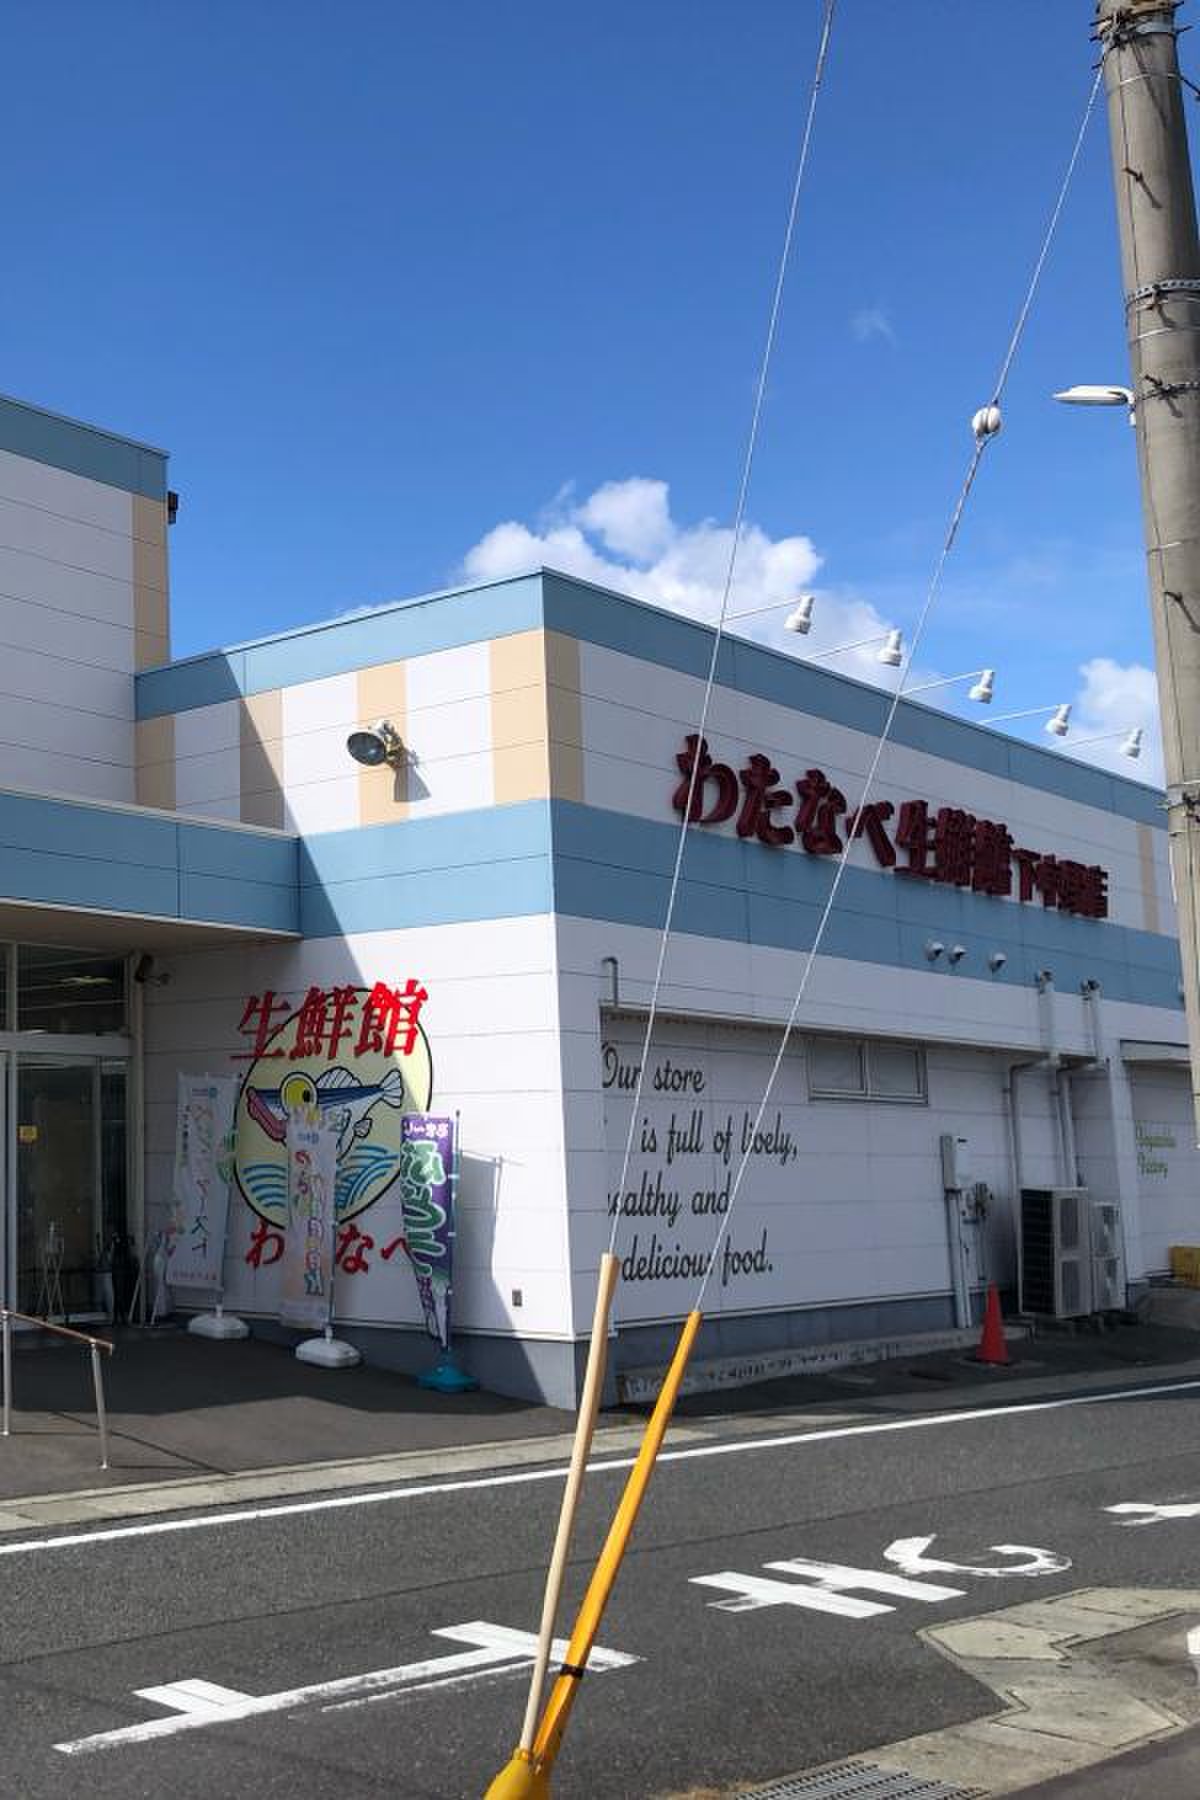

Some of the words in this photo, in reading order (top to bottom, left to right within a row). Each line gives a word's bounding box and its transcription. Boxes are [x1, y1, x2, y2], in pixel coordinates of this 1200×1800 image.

[230, 979, 428, 1060] 生鮮館
[654, 1060, 704, 1092] store
[640, 1119, 657, 1152] is
[667, 1109, 703, 1165] full
[713, 1115, 732, 1165] of
[691, 1171, 731, 1214] and
[722, 1228, 773, 1287] food.
